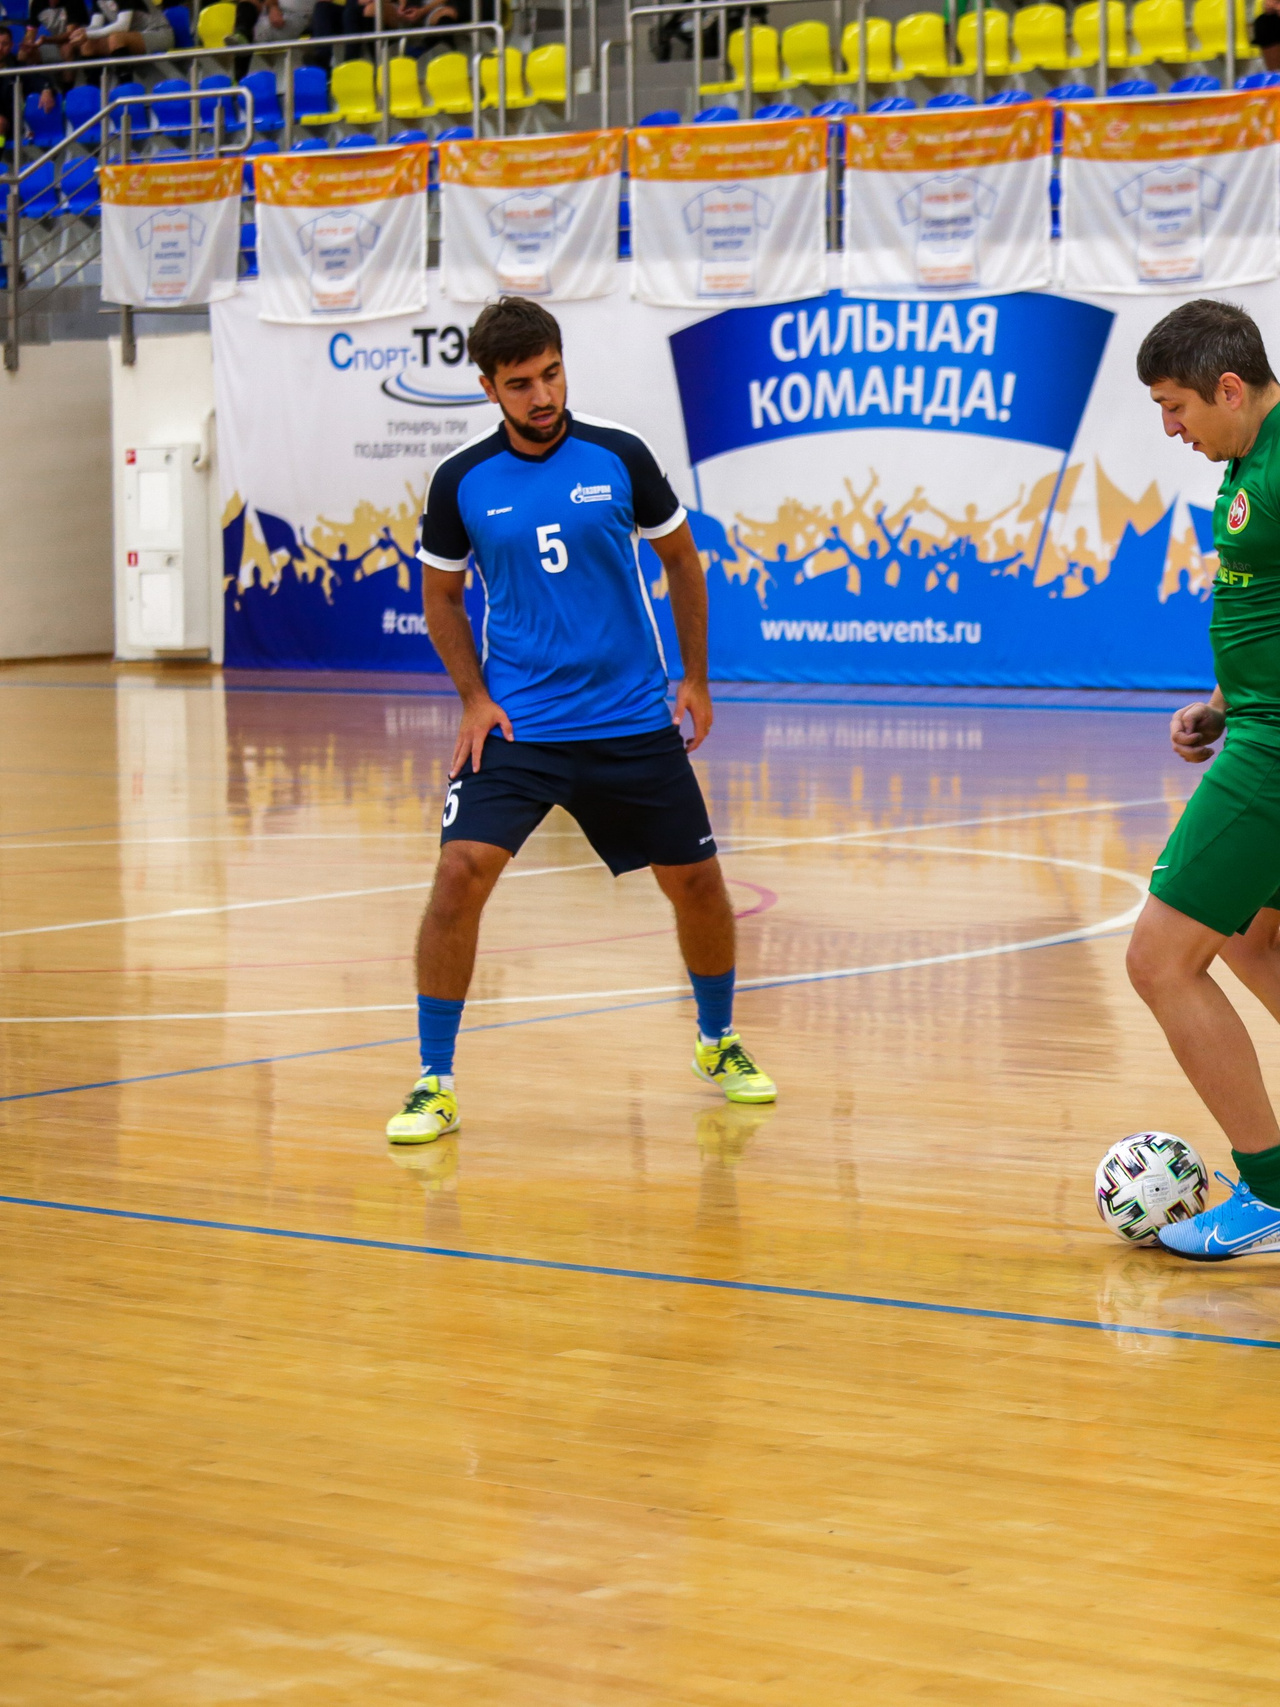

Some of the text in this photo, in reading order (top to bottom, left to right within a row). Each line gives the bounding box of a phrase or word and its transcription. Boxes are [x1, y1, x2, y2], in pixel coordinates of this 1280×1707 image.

[770, 302, 999, 362] СИЛЬНАЯ
[749, 365, 1017, 429] КОМАНДА!
[536, 523, 569, 574] 5
[761, 617, 983, 645] www.unevents.ru
[442, 780, 463, 828] 5
